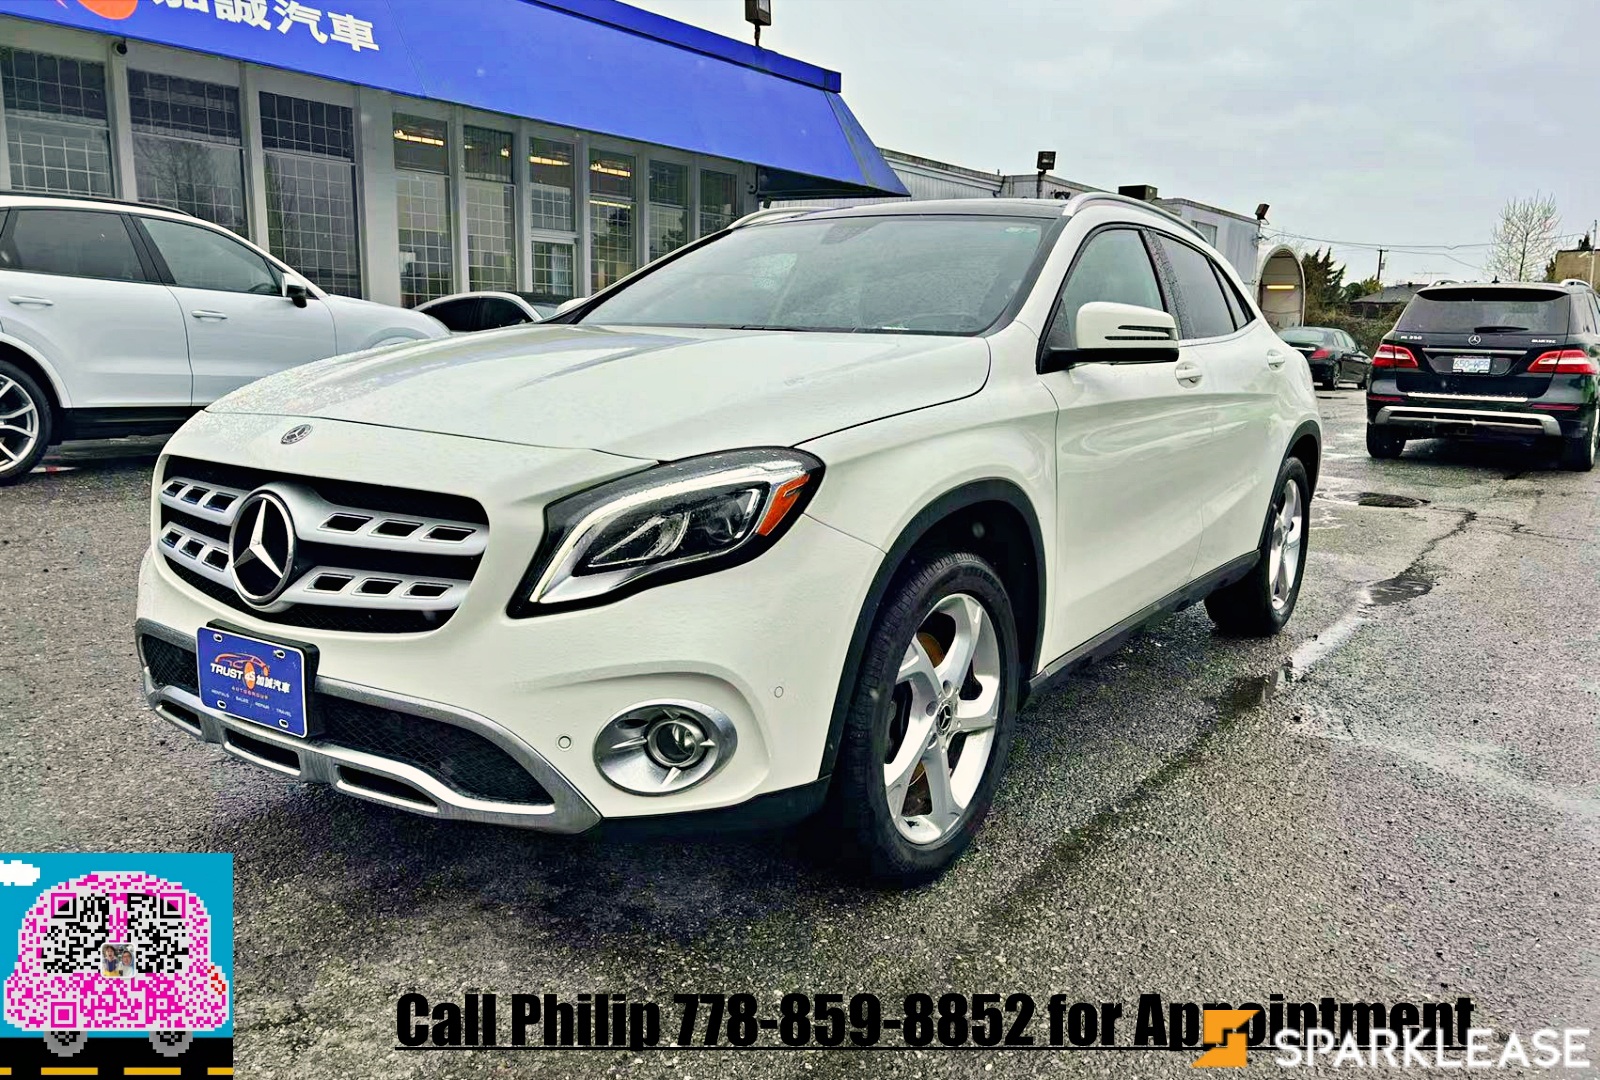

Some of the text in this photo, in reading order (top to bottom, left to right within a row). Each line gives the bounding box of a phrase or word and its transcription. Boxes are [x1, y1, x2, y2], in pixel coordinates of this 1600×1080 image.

[152, 0, 380, 52] 誠汽車
[210, 662, 244, 680] TRUST
